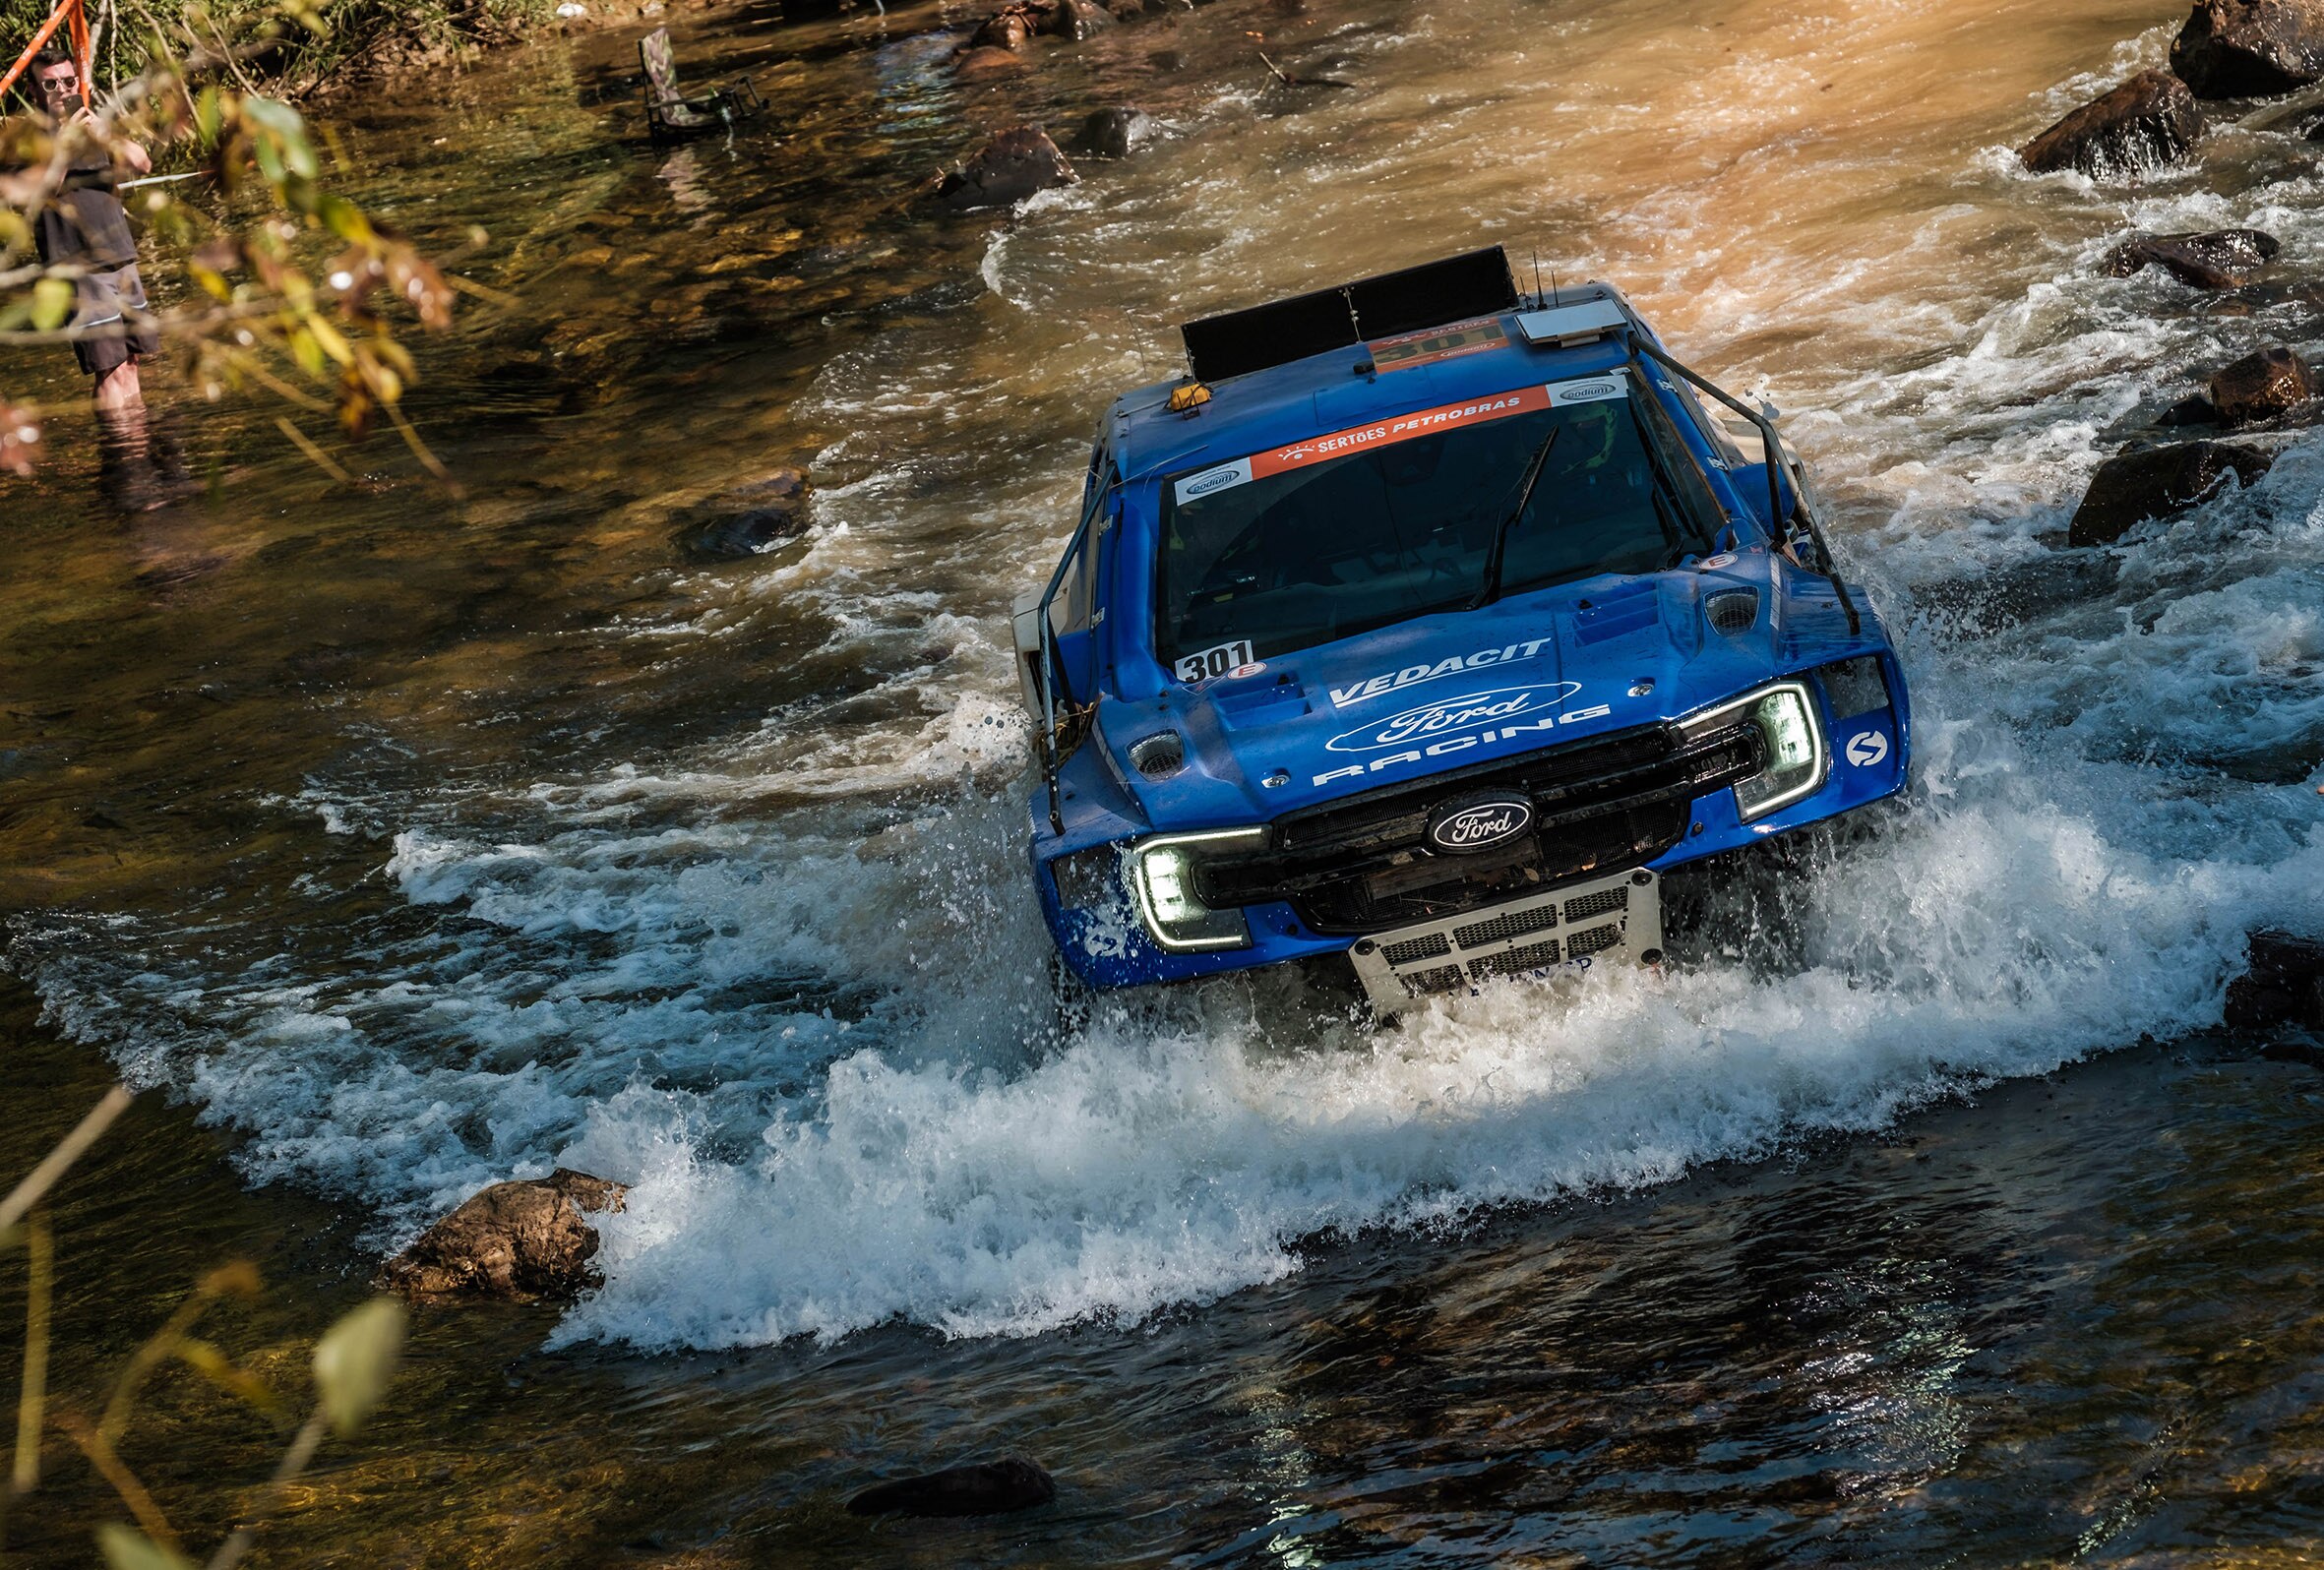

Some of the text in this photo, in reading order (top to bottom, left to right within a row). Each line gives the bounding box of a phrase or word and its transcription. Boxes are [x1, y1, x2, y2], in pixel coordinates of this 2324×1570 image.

[1392, 396, 1520, 434] PETROBRAS
[1193, 472, 1232, 493] podium
[1184, 641, 1248, 684] 301
[1329, 637, 1551, 704] VEDACIT
[1376, 693, 1531, 743] Ford
[1312, 703, 1611, 787] RACING
[1451, 810, 1512, 843] Ford
